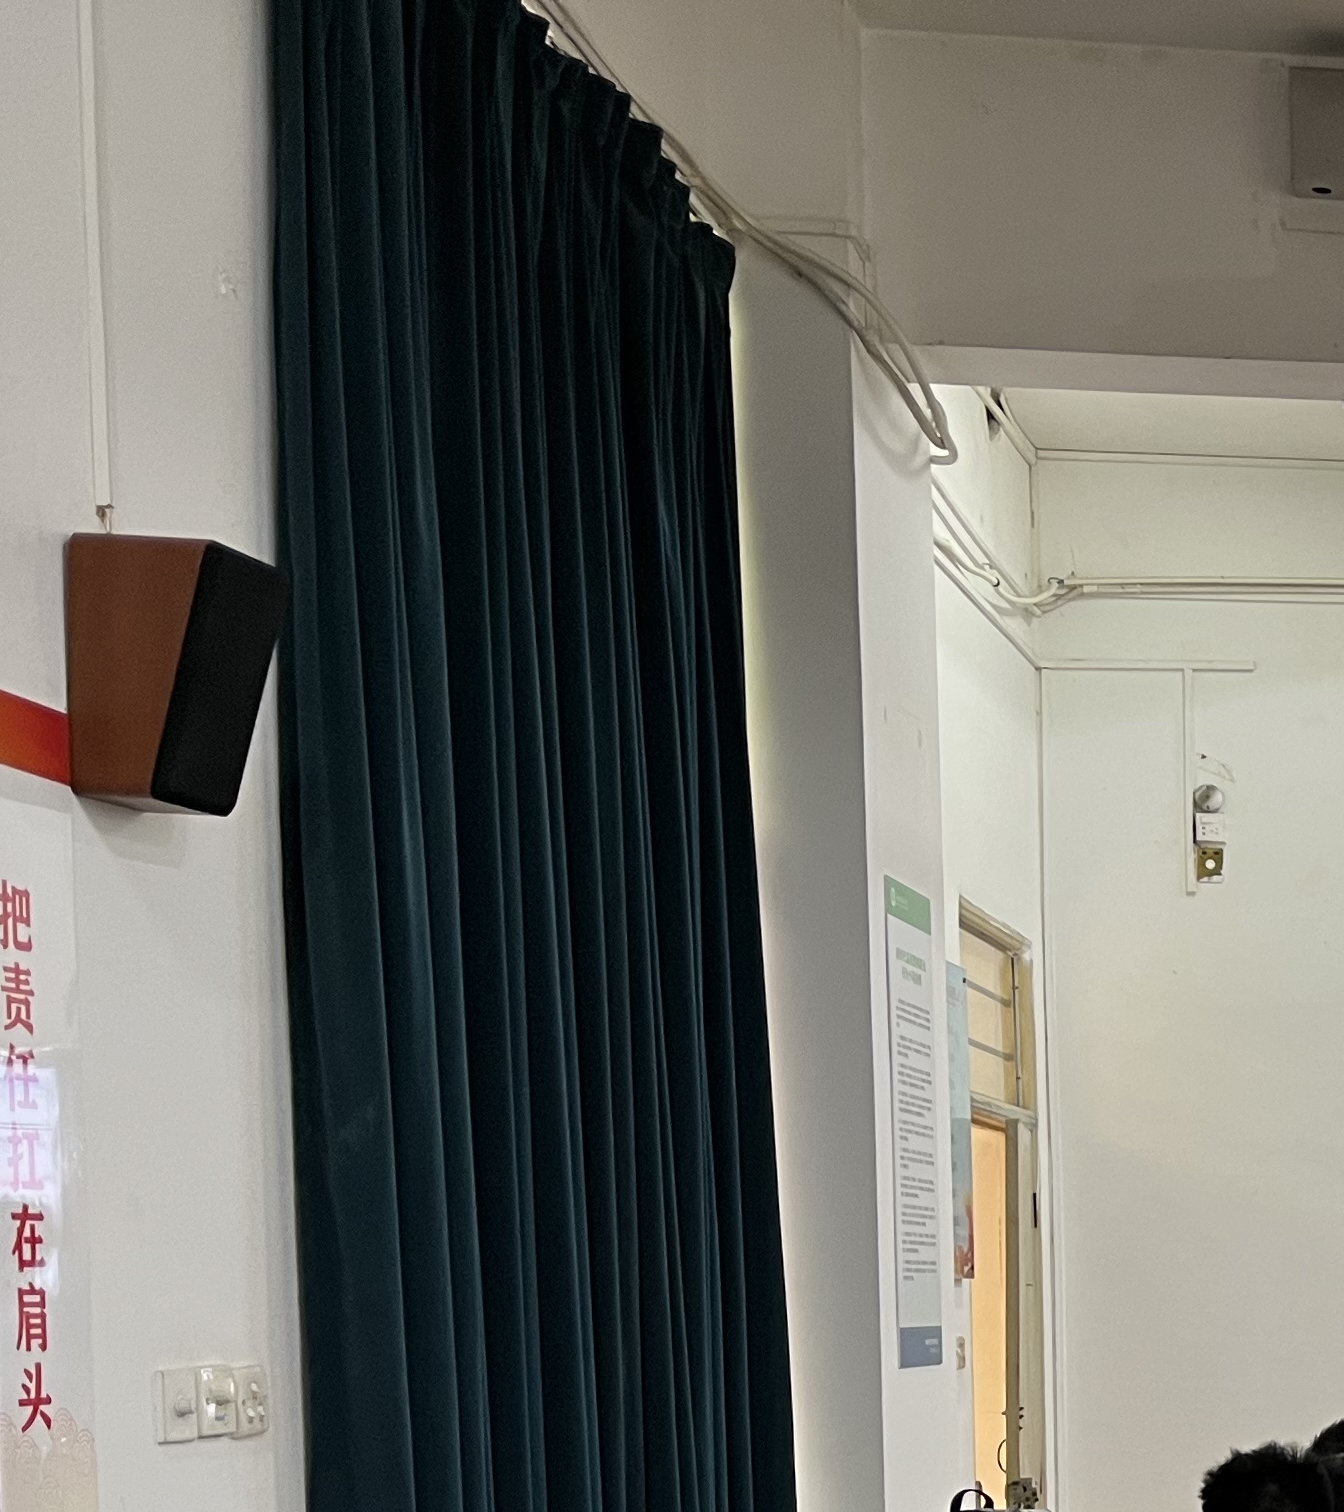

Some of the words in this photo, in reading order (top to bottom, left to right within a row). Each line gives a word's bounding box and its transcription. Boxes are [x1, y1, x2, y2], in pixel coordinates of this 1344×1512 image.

[0, 879, 52, 1434] 把责任扛在肩头
